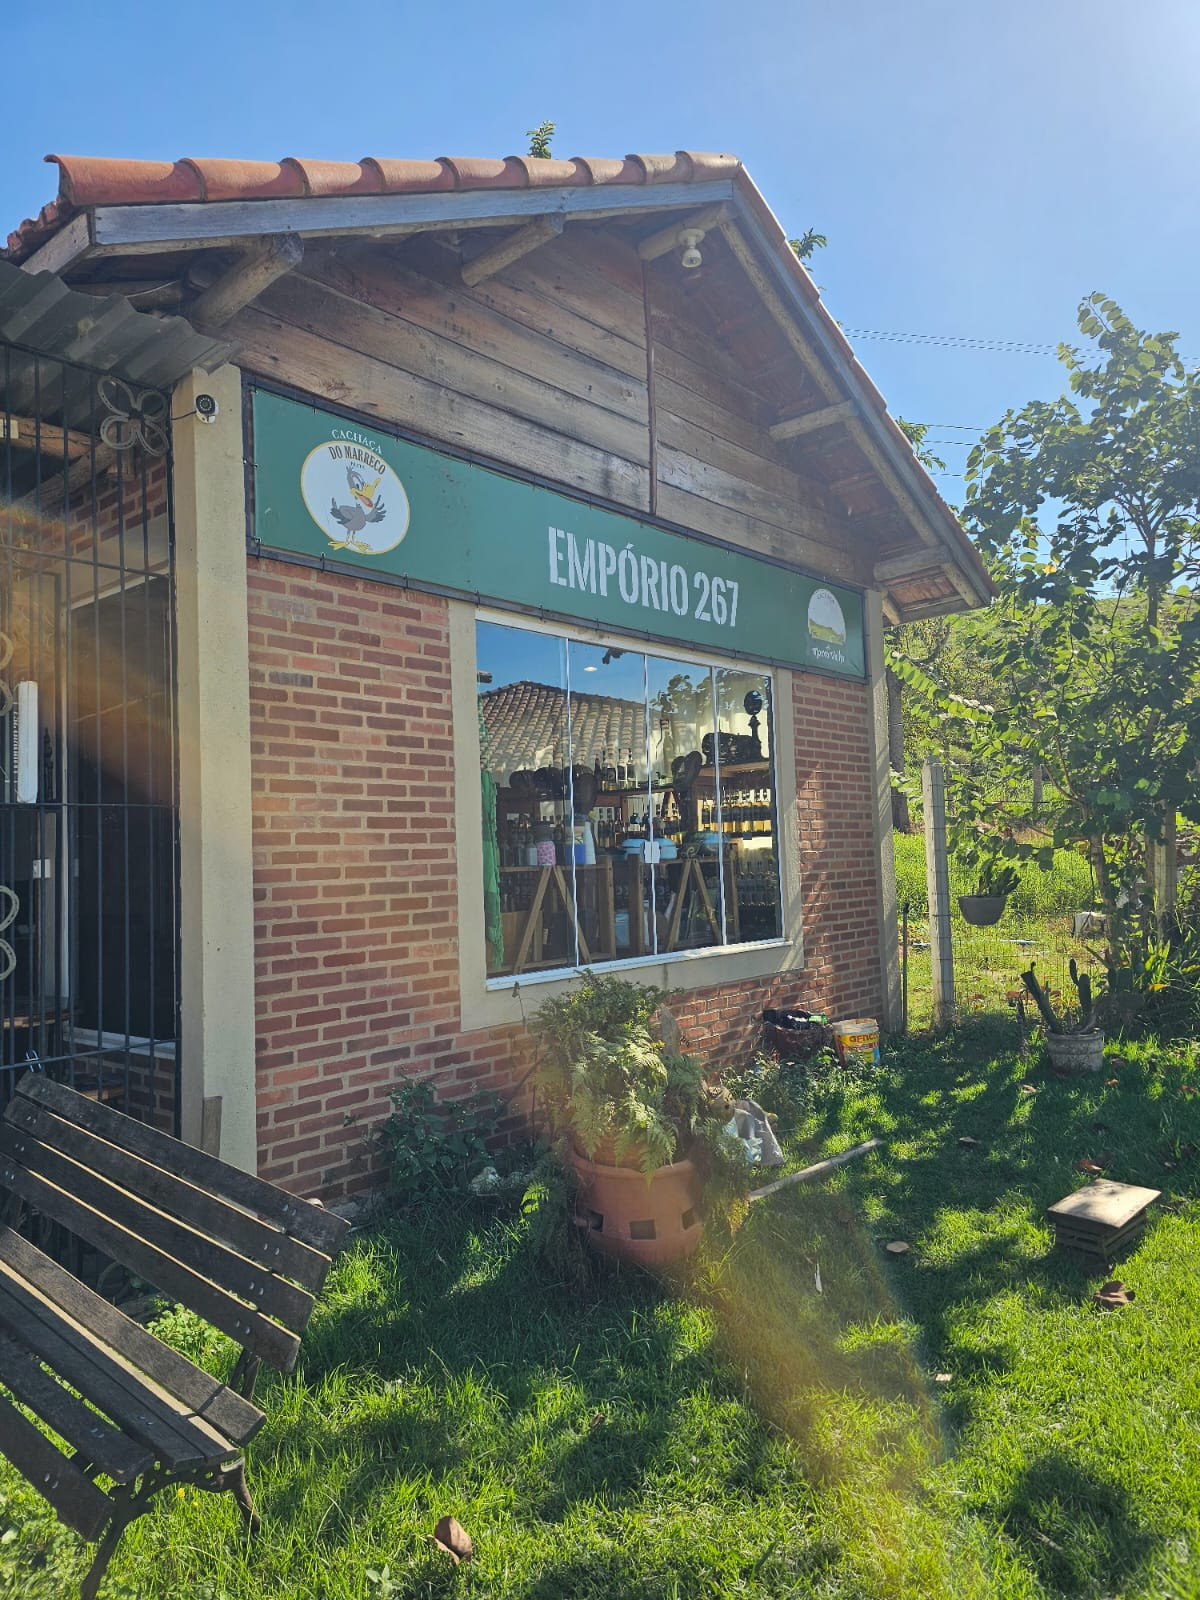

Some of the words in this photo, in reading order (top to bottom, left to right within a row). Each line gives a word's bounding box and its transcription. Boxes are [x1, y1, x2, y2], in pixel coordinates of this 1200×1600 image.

[331, 429, 382, 454] CACHAÇA
[328, 445, 343, 460] DO
[344, 445, 386, 475] MARRECO
[548, 526, 689, 616] EMPÓRIO
[693, 571, 739, 627] 267
